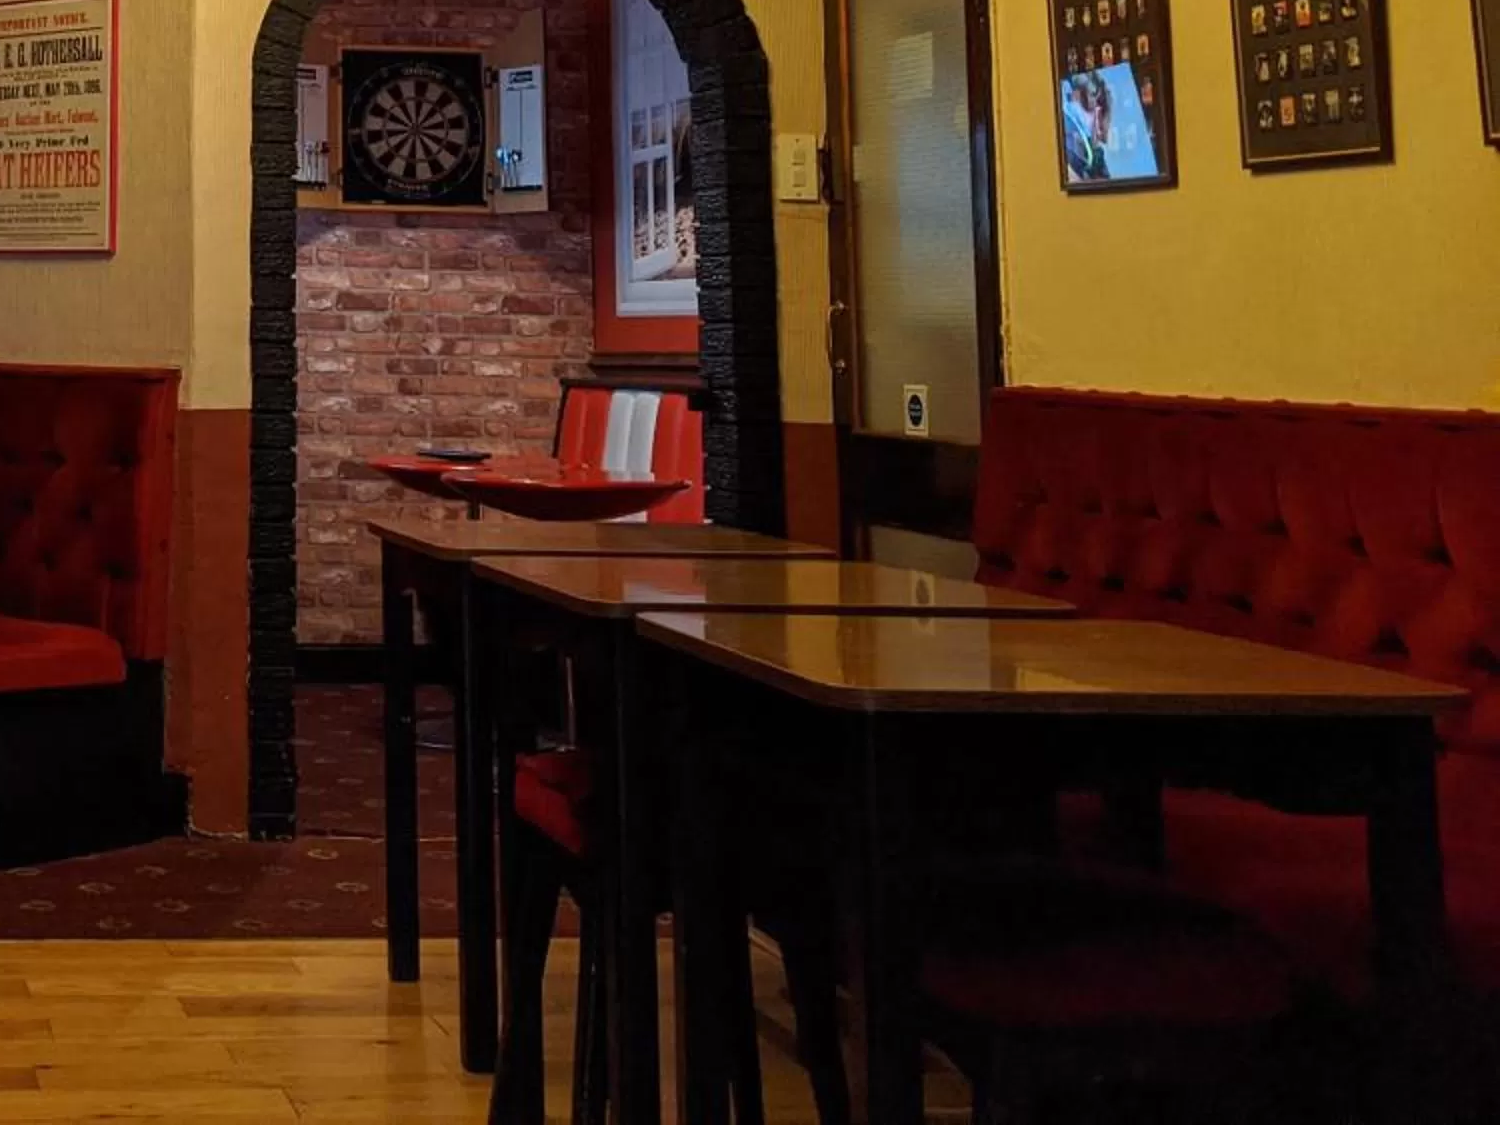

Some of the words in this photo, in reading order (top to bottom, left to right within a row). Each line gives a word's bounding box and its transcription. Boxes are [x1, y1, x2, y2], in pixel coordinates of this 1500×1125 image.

[8, 137, 31, 150] Very
[35, 136, 66, 148] Prime
[17, 149, 102, 189] HEIFERS
